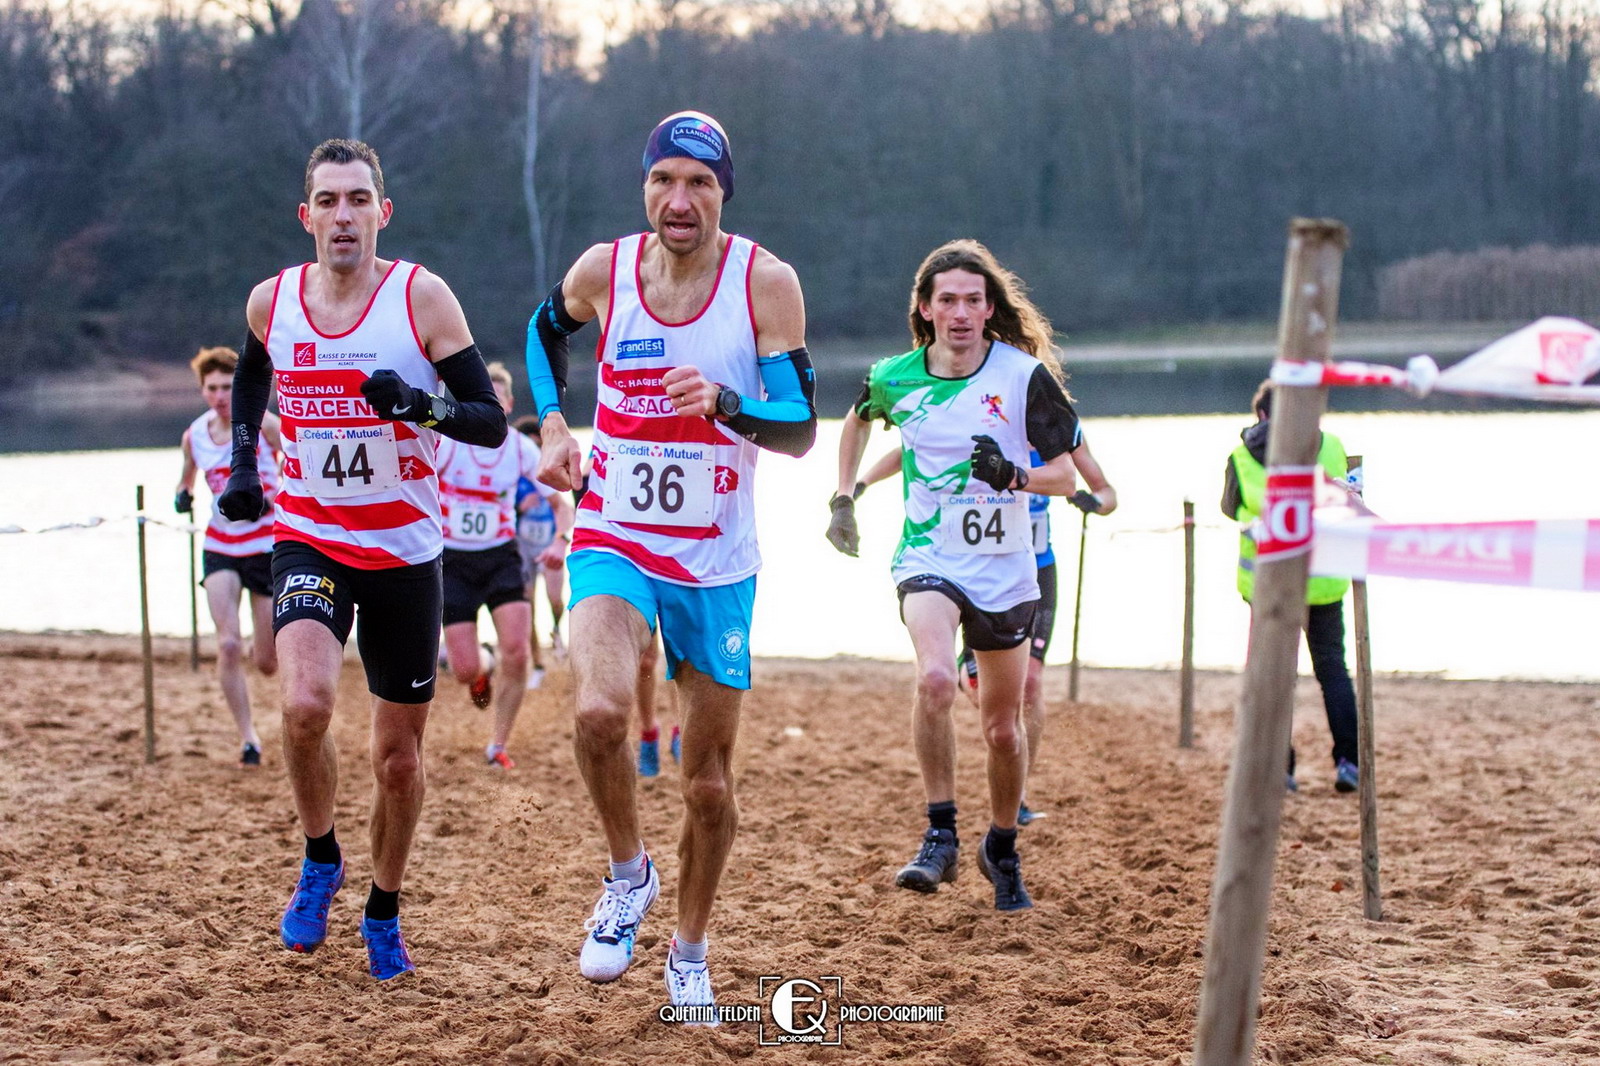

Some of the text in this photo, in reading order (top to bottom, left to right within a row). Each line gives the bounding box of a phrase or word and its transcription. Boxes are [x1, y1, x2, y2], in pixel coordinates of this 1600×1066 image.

[348, 352, 378, 360] EPARGNE
[353, 400, 378, 417] N
[616, 396, 678, 415] ALSAC
[239, 424, 251, 446] GORE
[304, 428, 382, 439] Crédit Mutuel
[618, 444, 703, 460] Crédit Mutuel
[322, 443, 374, 487] 44
[630, 462, 684, 514] 36
[949, 495, 1016, 505] Crédit Mutuel
[462, 512, 487, 535] 50
[962, 508, 1006, 546] 64
[276, 595, 334, 619] LE TEAM
